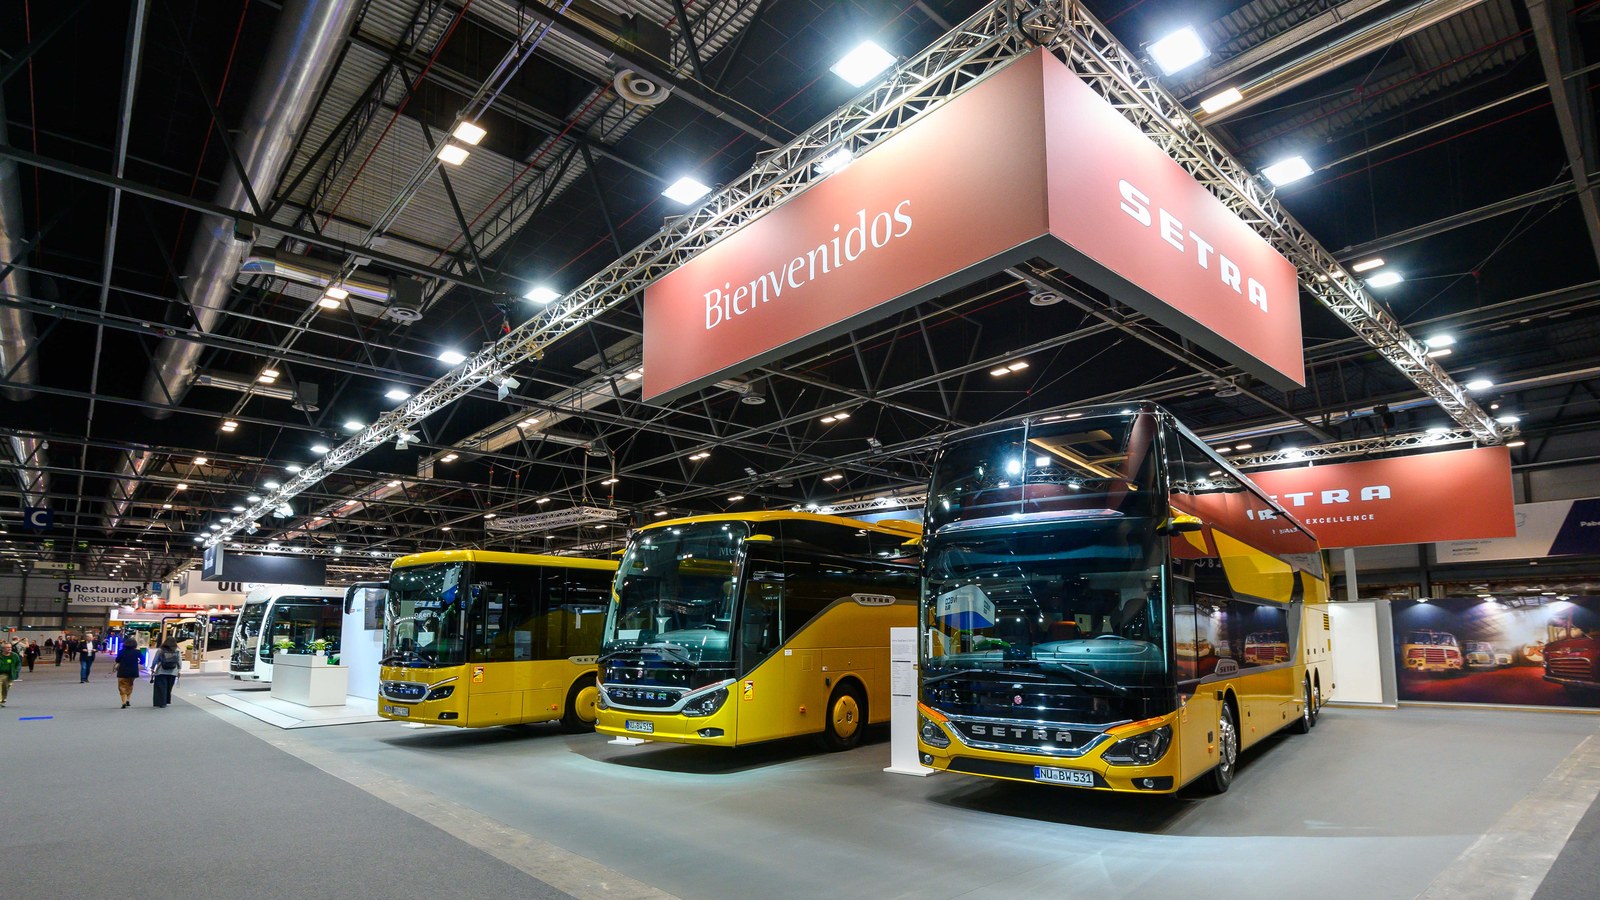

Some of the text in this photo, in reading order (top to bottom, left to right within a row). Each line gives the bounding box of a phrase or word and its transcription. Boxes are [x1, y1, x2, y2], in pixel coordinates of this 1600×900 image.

[1119, 179, 1268, 312] SETRA
[704, 199, 913, 330] Bienvenidos
[1270, 485, 1390, 506] TRA
[31, 511, 47, 526] C
[1306, 514, 1375, 524] EXCELLENCE
[74, 584, 139, 593] Restauran
[616, 690, 667, 700] SETRA
[971, 725, 1072, 742] SETRA
[1040, 769, 1092, 783] NU BW 531
